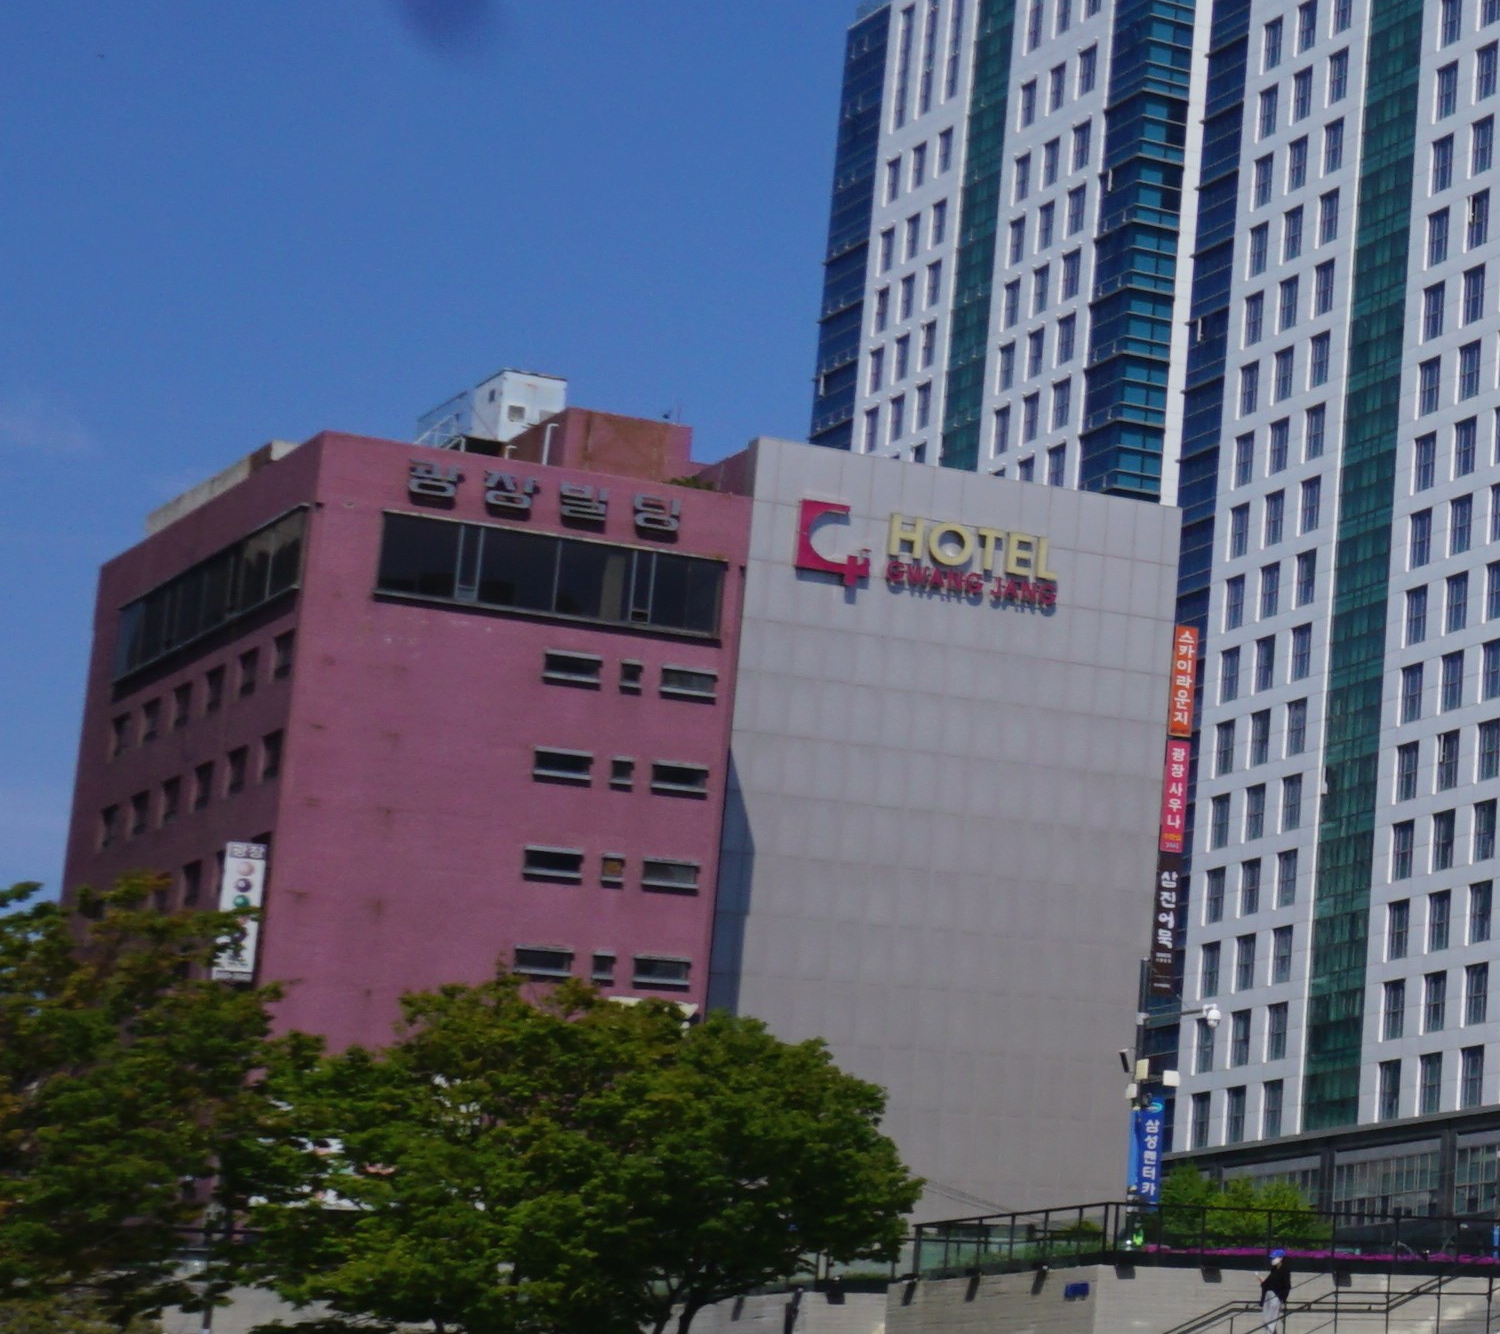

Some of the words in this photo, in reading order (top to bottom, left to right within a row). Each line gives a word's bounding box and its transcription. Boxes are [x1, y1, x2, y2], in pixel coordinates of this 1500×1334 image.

[407, 459, 683, 532] 광장빌딩
[887, 512, 1058, 581] HOTEL
[886, 560, 984, 594] GWANG
[990, 575, 1058, 606] JANG
[1173, 630, 1195, 726] 스카이라운지
[1170, 747, 1186, 778] 광장
[1166, 782, 1183, 829] 사우나
[1140, 1118, 1161, 1197] 삼성렌터카
